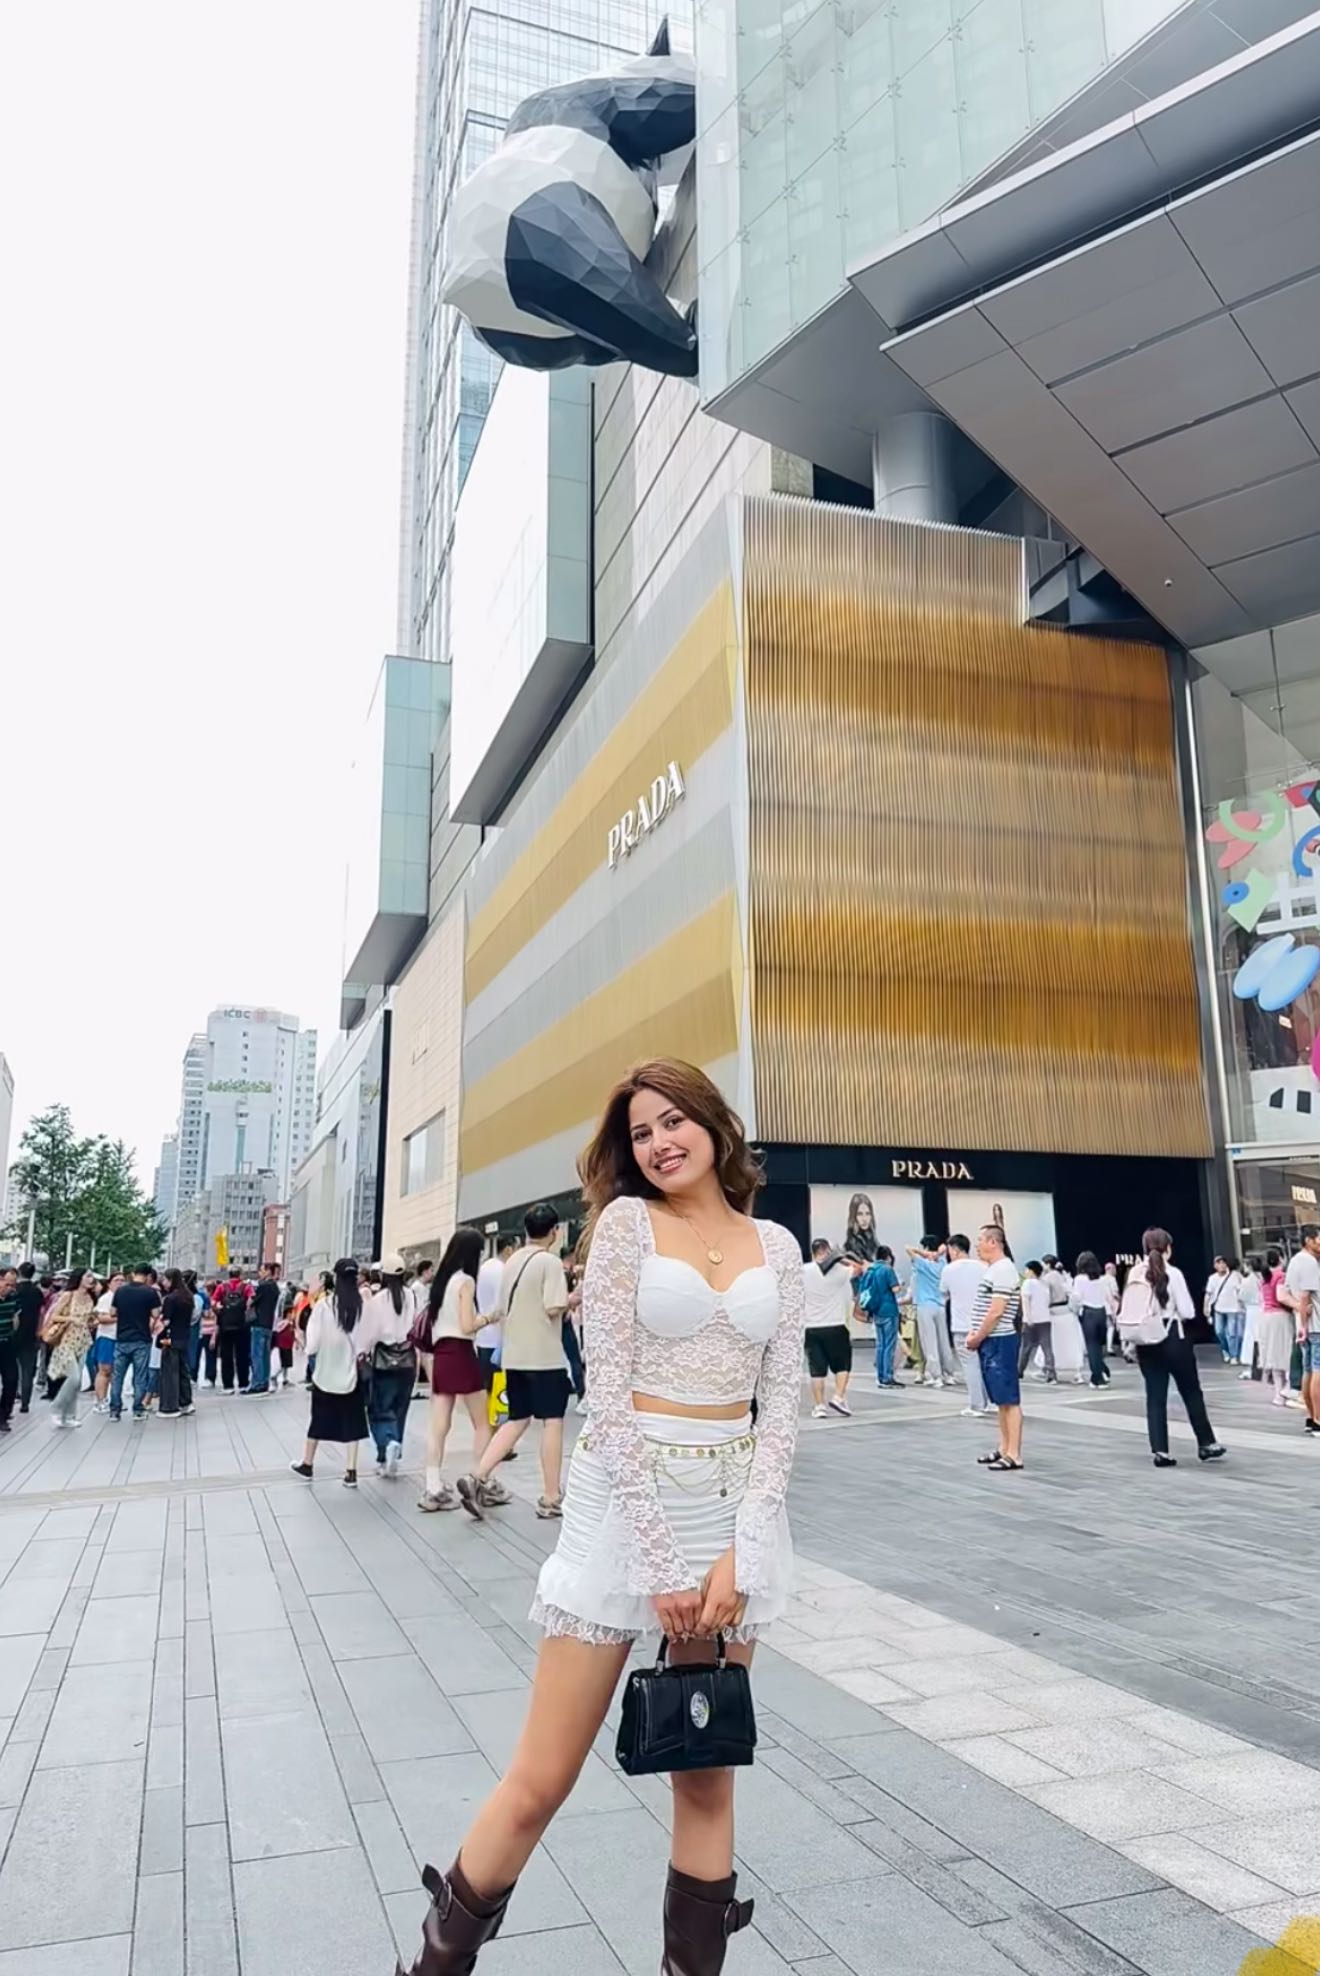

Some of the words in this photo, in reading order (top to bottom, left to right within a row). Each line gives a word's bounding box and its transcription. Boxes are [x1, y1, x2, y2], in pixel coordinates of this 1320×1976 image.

[607, 760, 686, 870] PRADA
[224, 1009, 251, 1019] ICBC
[891, 1159, 974, 1181] PRADA
[1115, 1253, 1147, 1266] PRA
